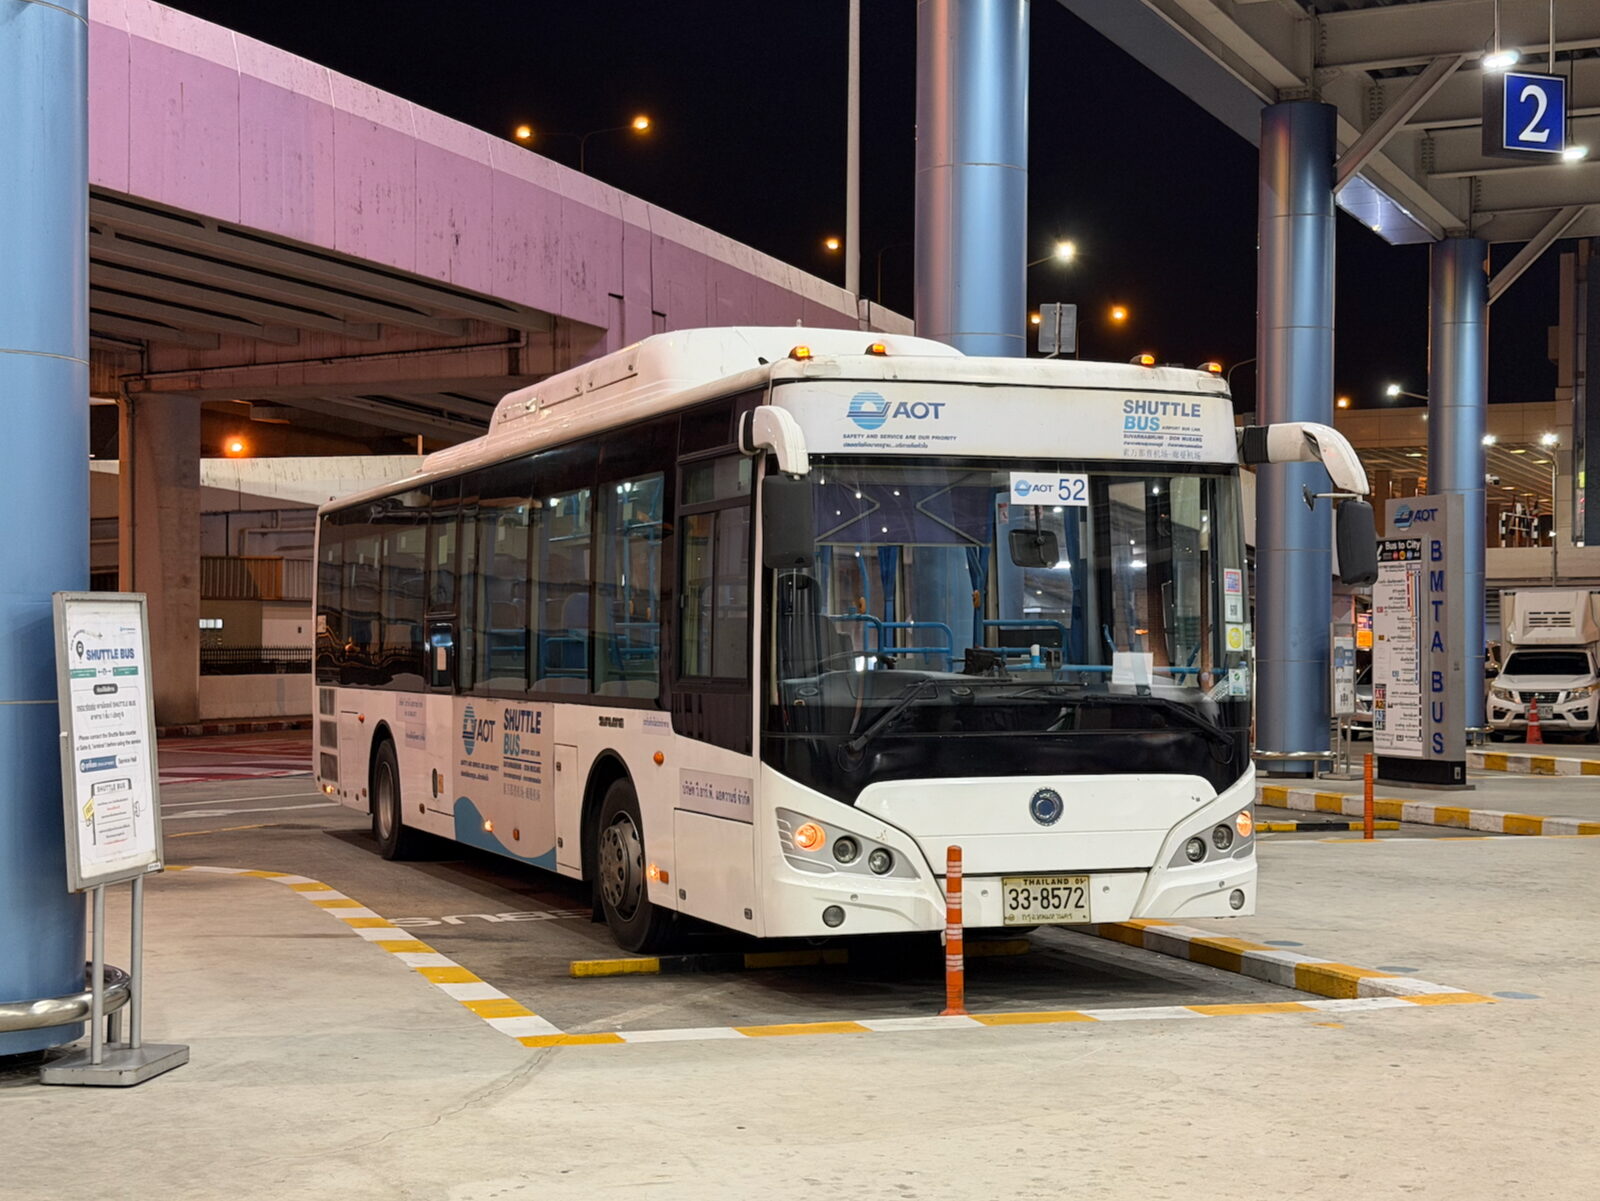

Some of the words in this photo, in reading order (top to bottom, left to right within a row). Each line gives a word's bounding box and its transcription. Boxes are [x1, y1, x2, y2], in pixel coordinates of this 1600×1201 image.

[1518, 84, 1550, 143] 2
[892, 401, 946, 420] AOT
[1123, 400, 1201, 418] SHUTTLE
[1124, 415, 1160, 431] BUS
[1032, 484, 1054, 492] AOT
[1058, 478, 1086, 500] 52
[1414, 508, 1438, 522] AOT
[1385, 541, 1397, 550] Bus
[1398, 541, 1405, 549] to
[1406, 540, 1420, 551] City
[1430, 540, 1444, 652] BMTA
[86, 648, 118, 660] SHUTTLE
[121, 648, 135, 659] BUS
[504, 708, 542, 734] SHUTTLE
[1431, 671, 1444, 754] BUS
[476, 719, 496, 742] AOT
[504, 733, 520, 756] BUS
[96, 784, 116, 792] SHUTTLE
[1009, 887, 1085, 910] 33-8572
